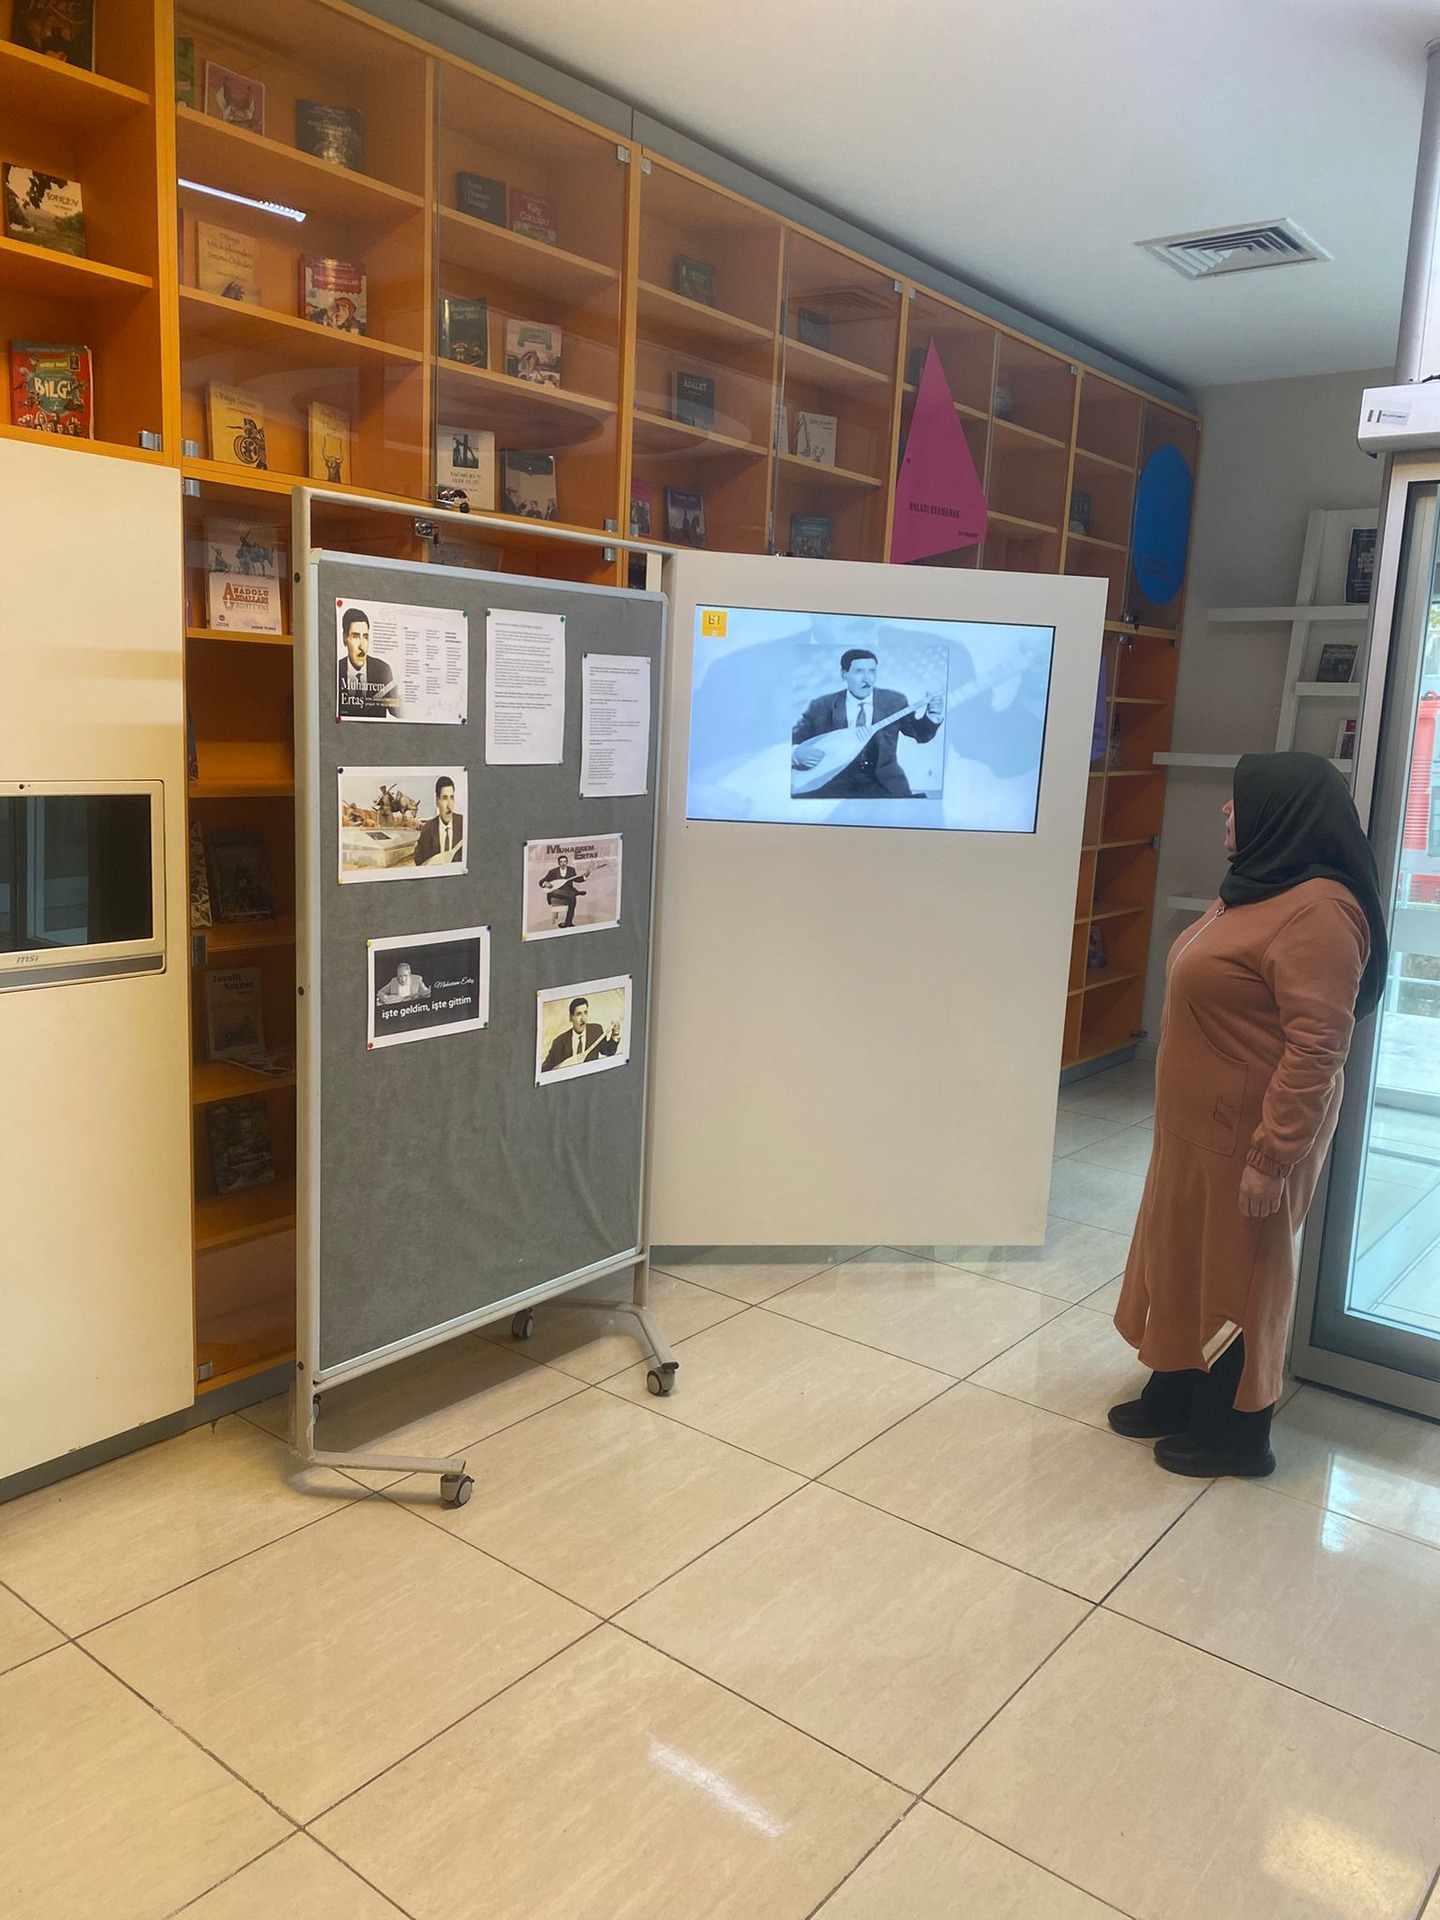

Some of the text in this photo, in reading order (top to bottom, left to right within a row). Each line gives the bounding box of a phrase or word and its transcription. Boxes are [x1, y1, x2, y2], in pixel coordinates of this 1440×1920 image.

[222, 582, 269, 601] ANADOLU
[341, 677, 385, 692] Muharrem
[341, 692, 365, 709] Ertaş
[16, 952, 40, 964] msi
[381, 995, 472, 1021] işte geldim, işte gittim
